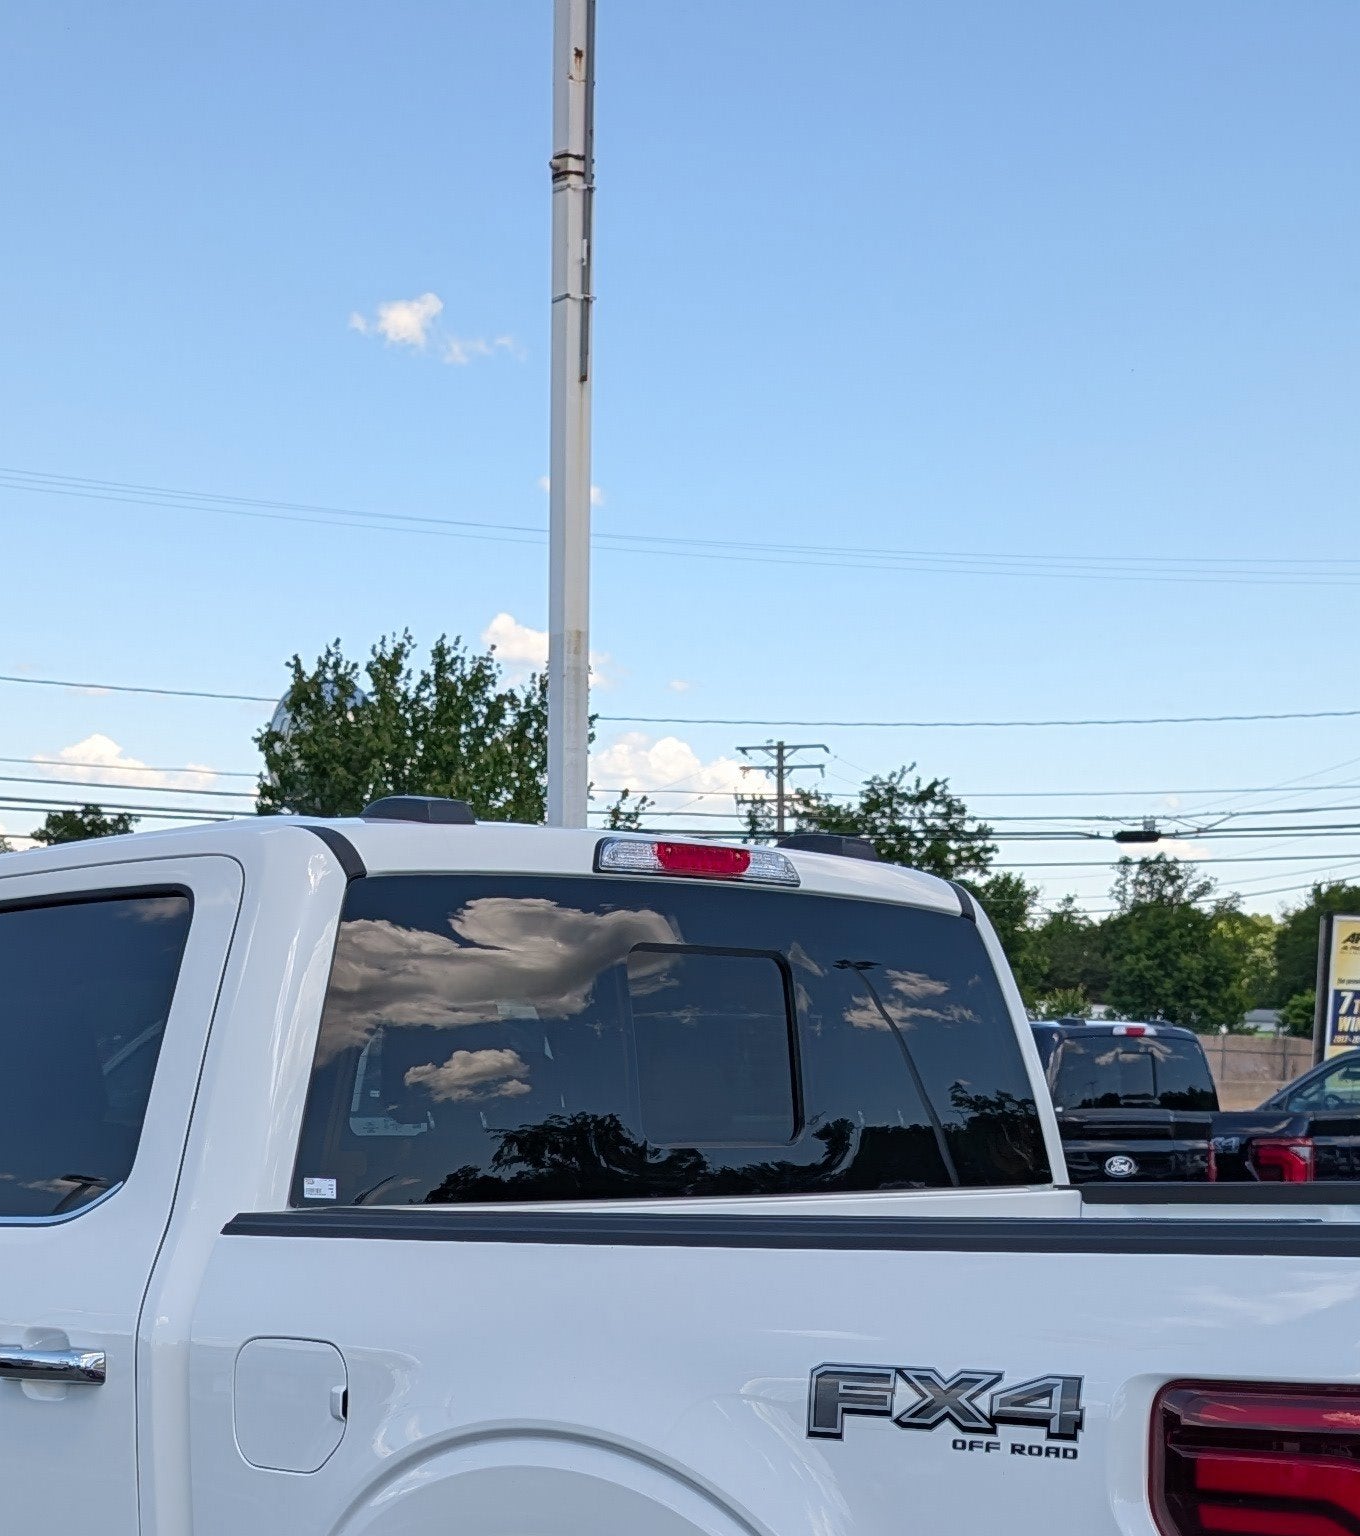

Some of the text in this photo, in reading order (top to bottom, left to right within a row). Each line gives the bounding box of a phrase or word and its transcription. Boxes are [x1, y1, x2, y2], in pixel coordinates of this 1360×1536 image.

[1338, 991, 1354, 1014] 7
[806, 1361, 1086, 1442] FX4
[951, 1438, 1079, 1460] OFF ROAD
